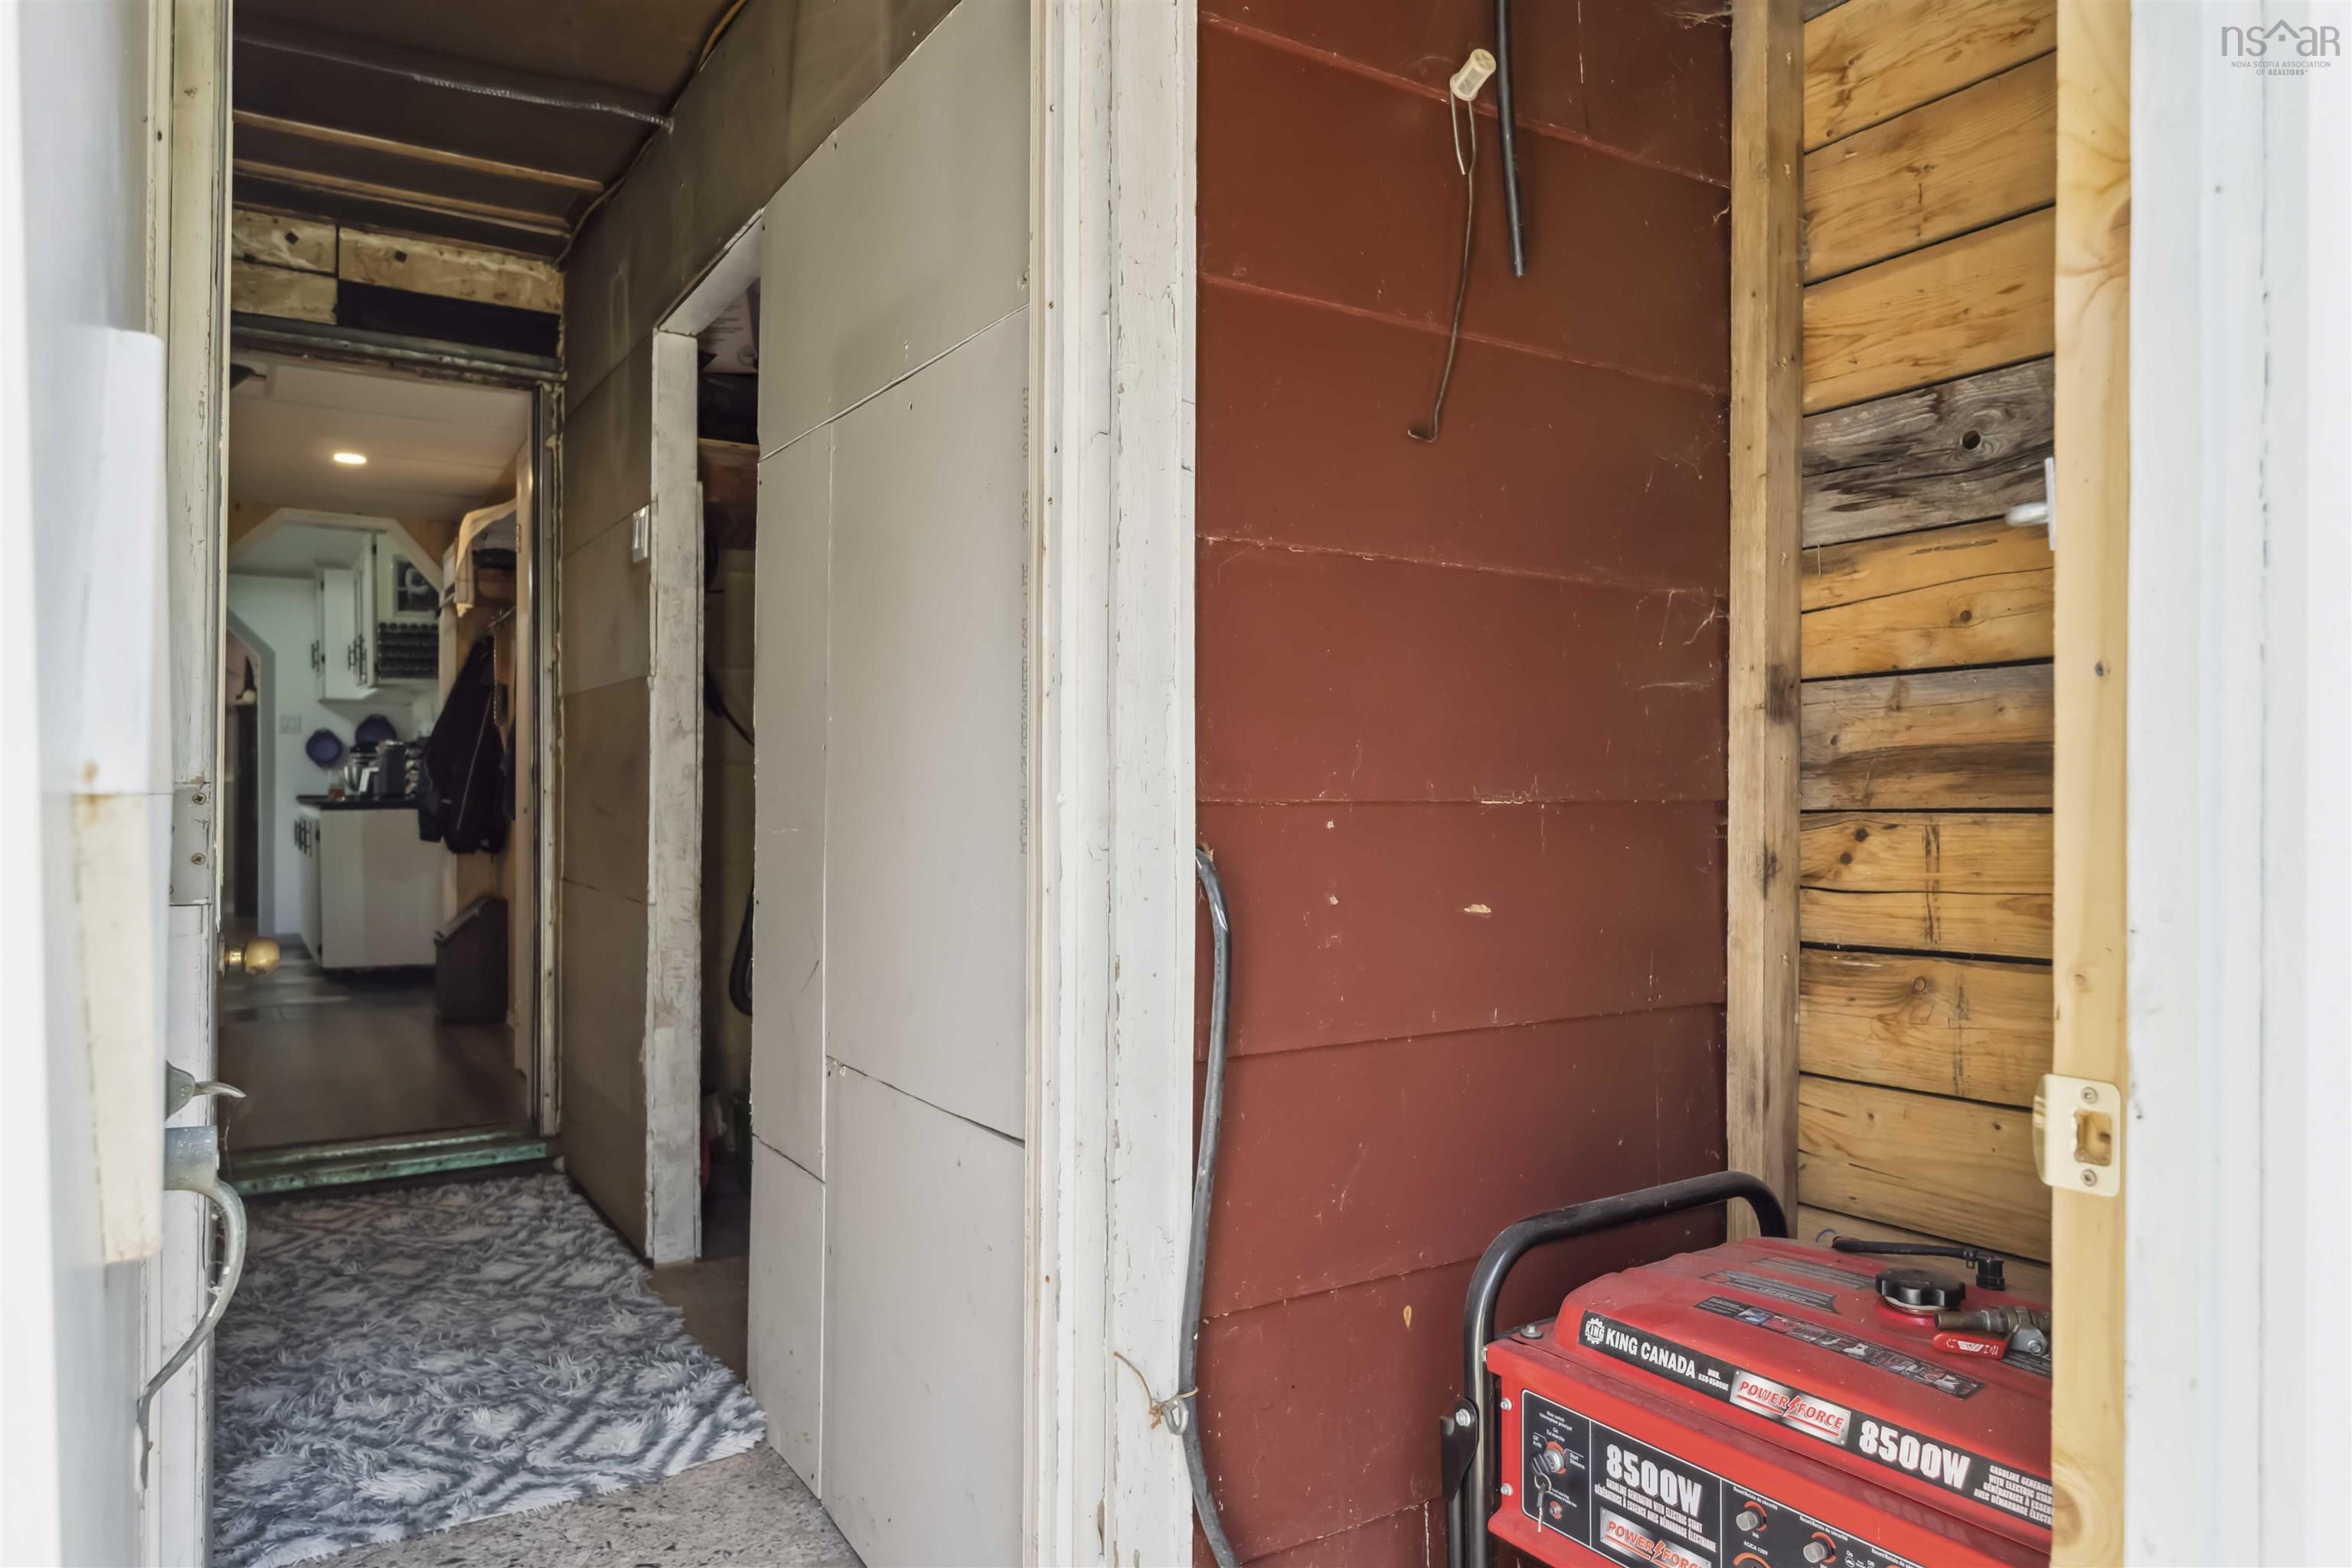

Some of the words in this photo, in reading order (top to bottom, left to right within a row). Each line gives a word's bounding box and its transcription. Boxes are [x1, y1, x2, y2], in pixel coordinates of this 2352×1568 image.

[1585, 1322, 1605, 1340] KING
[1606, 1328, 1638, 1356] KING
[1641, 1342, 1696, 1379] CANADA
[1739, 1380, 1789, 1409] POWER
[1797, 1400, 1844, 1430] FORCE
[1858, 1419, 1971, 1490] 8500W
[1606, 1443, 1703, 1517] 8500W
[1982, 1481, 2024, 1505] GÉNÉRATRICE
[1988, 1474, 2005, 1488] WITH
[2005, 1480, 2035, 1498] ELECTRIC
[1989, 1465, 2021, 1484] GASOLINE
[1973, 1488, 1990, 1501] AVEC
[1991, 1494, 2029, 1517] DÉMARRAGE
[1607, 1520, 1655, 1553] POWER
[1662, 1547, 1704, 1568] FOR
